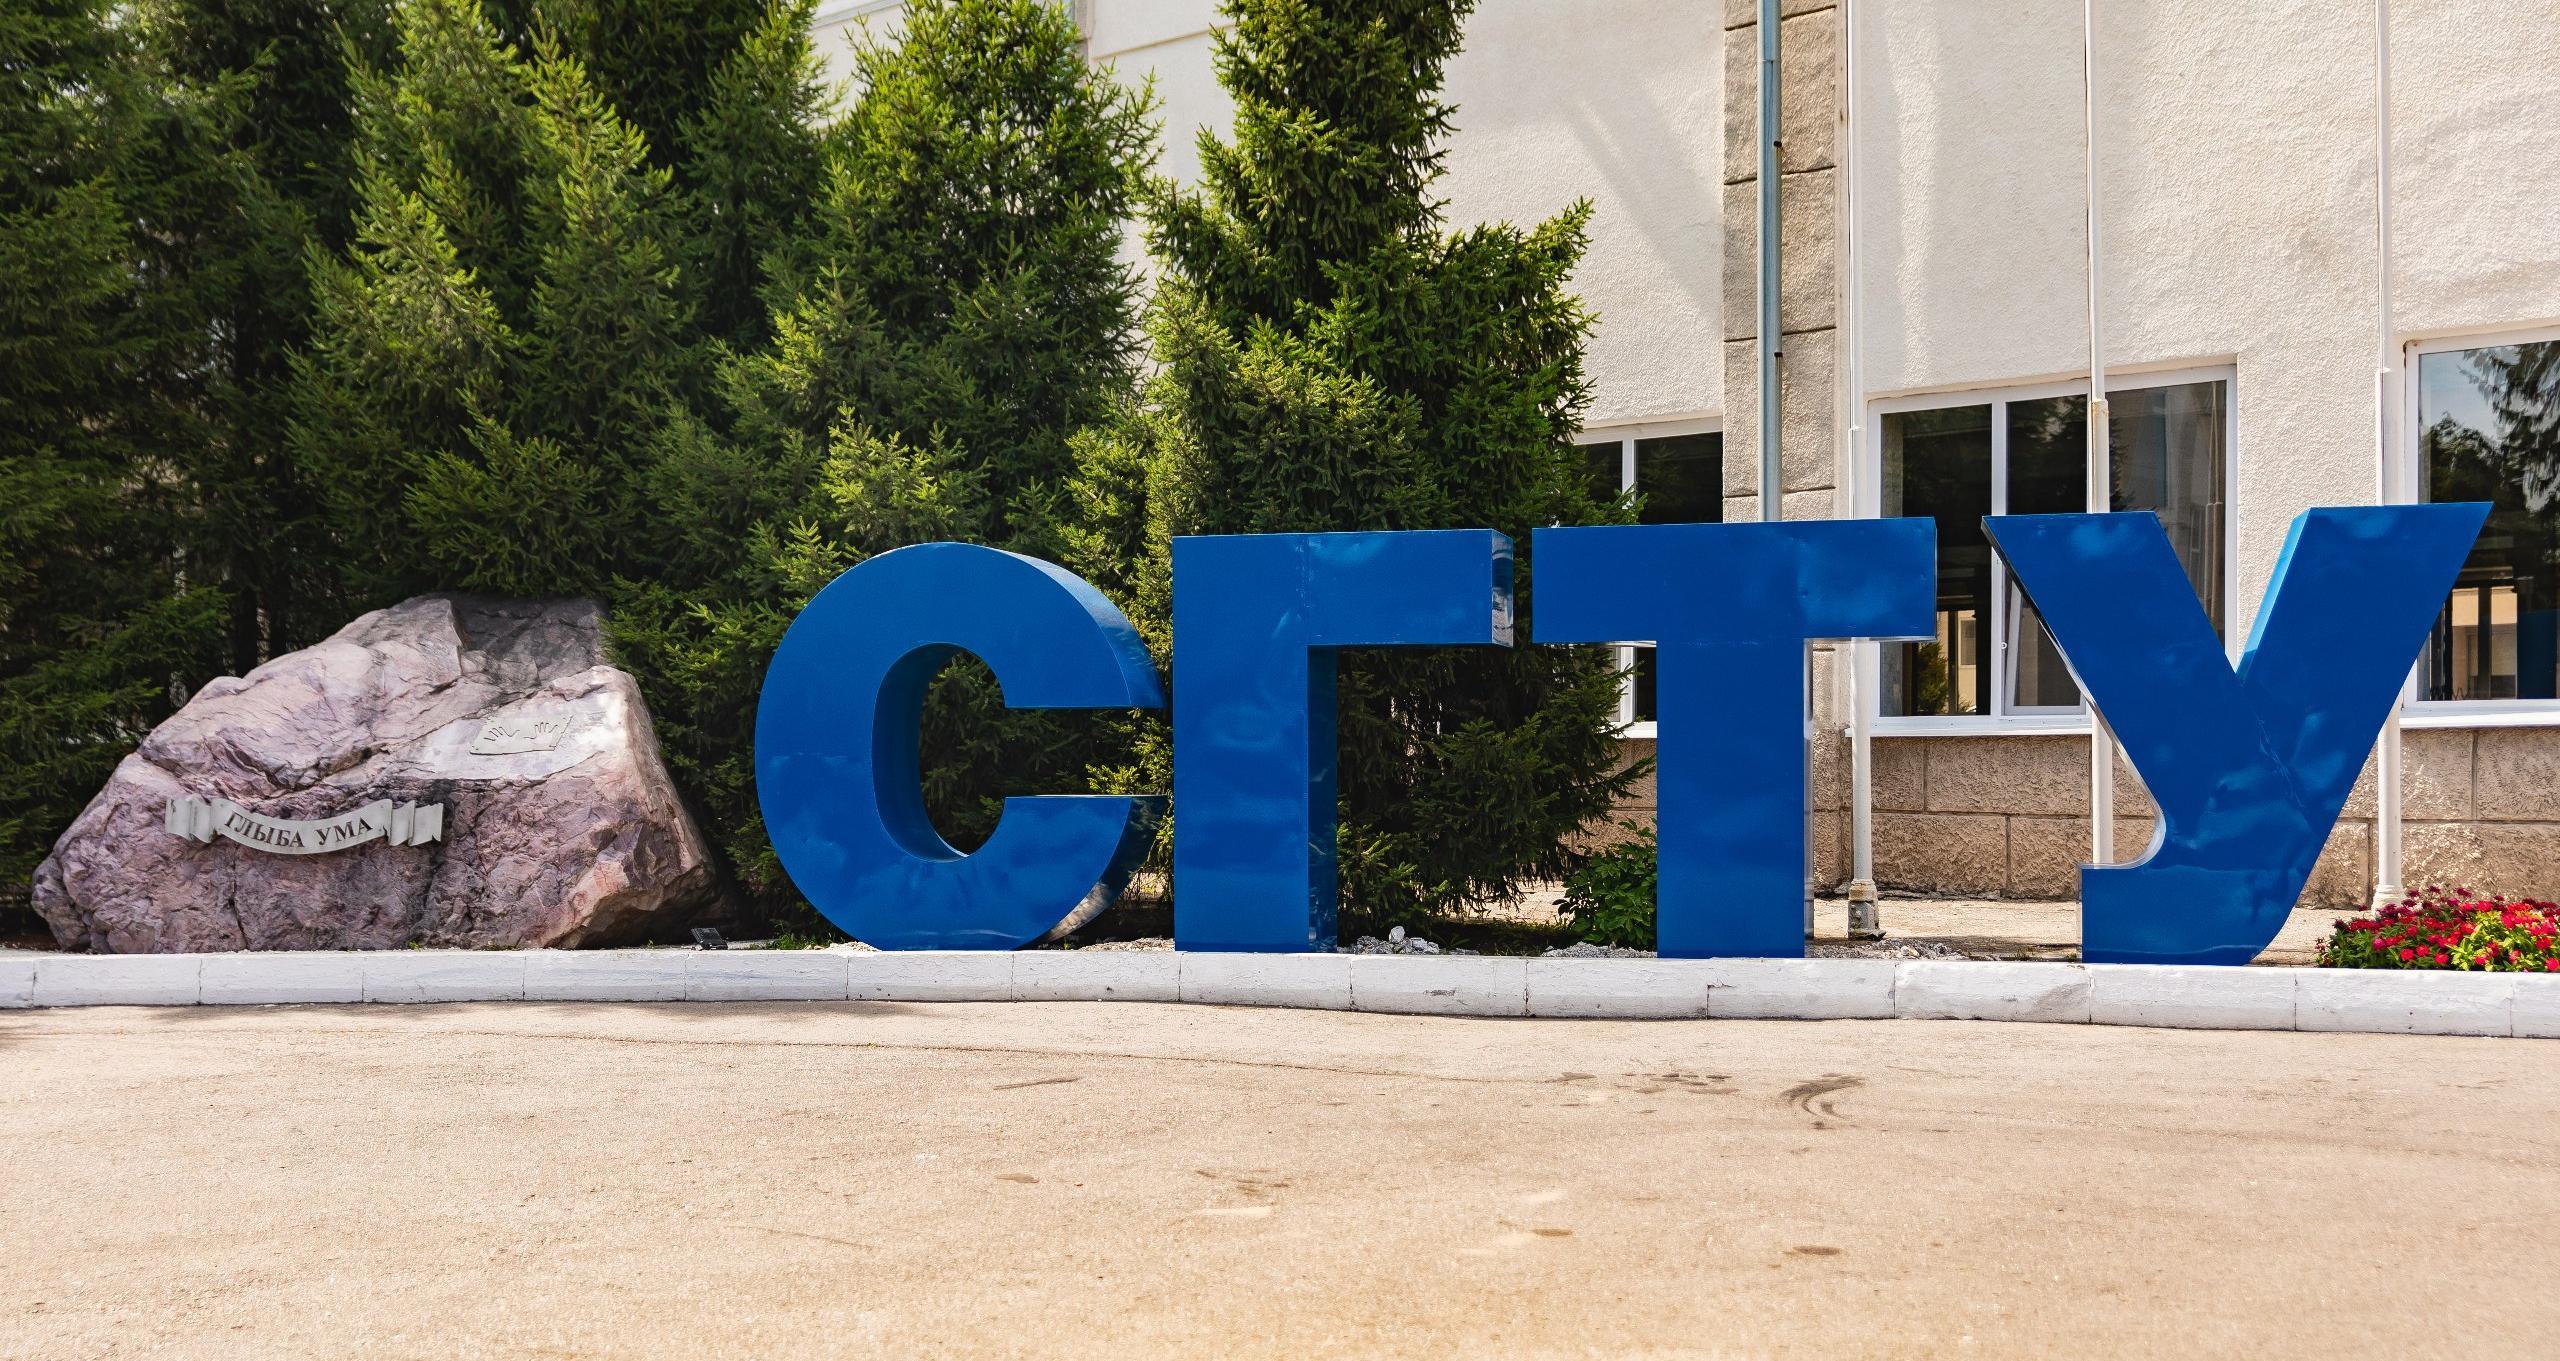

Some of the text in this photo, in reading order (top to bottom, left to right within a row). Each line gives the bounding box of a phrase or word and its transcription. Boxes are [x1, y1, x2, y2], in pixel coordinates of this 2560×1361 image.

[224, 812, 374, 848] ГЛЫБА УМА
[754, 501, 2493, 966] СГТУ
